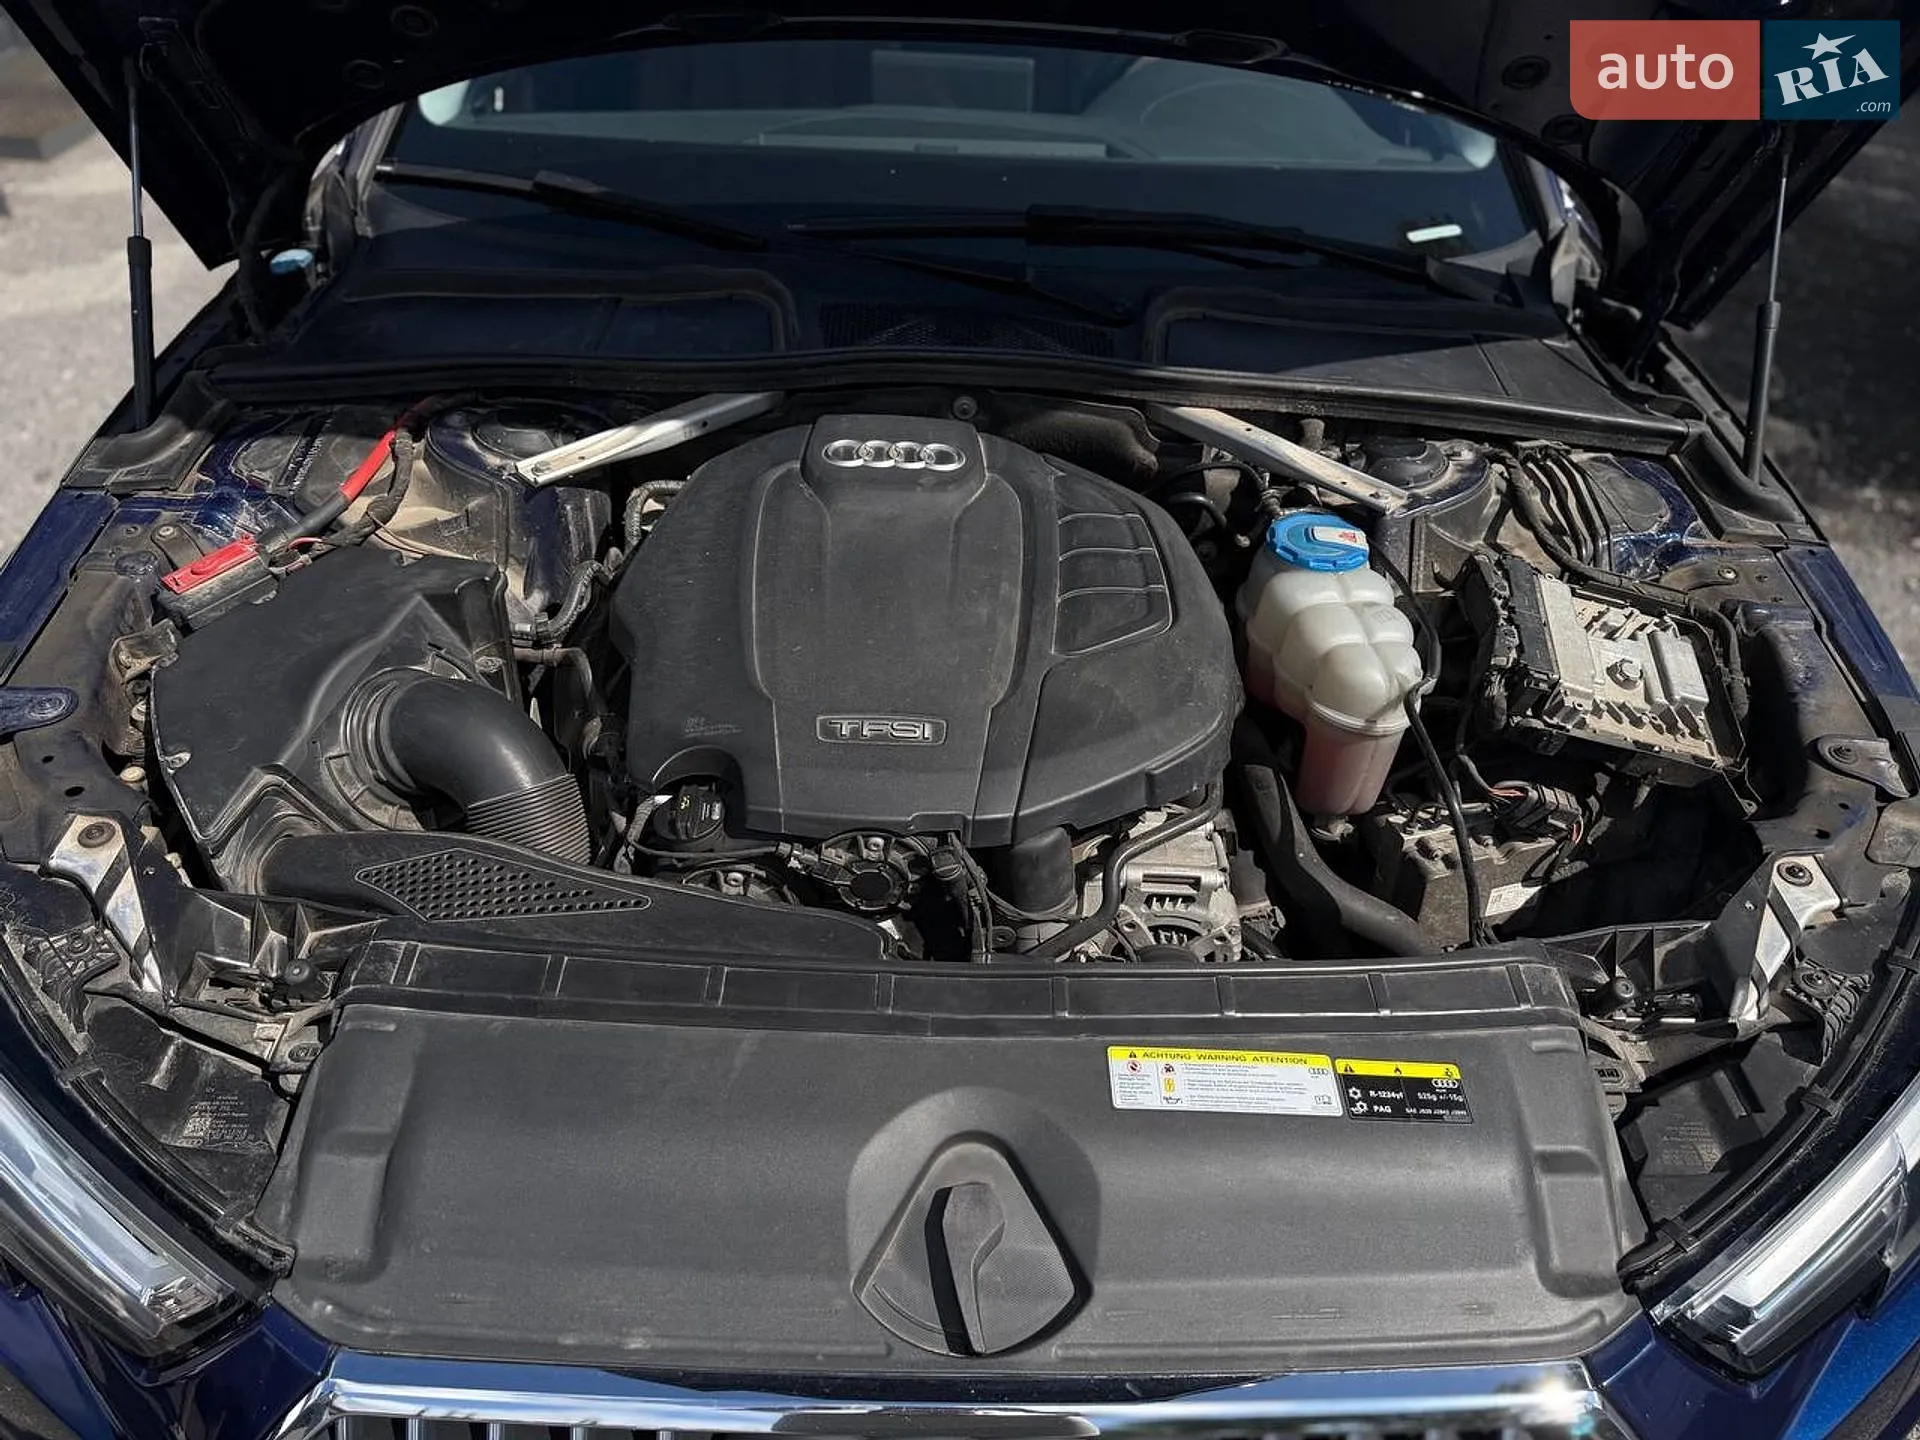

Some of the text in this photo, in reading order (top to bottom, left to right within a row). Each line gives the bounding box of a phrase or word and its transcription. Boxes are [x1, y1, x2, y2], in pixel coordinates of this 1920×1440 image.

[827, 720, 932, 741] TFSI
[1142, 1051, 1308, 1065] ACHTUNG WARNING ATTENTION
[1372, 1105, 1392, 1113] PAG
